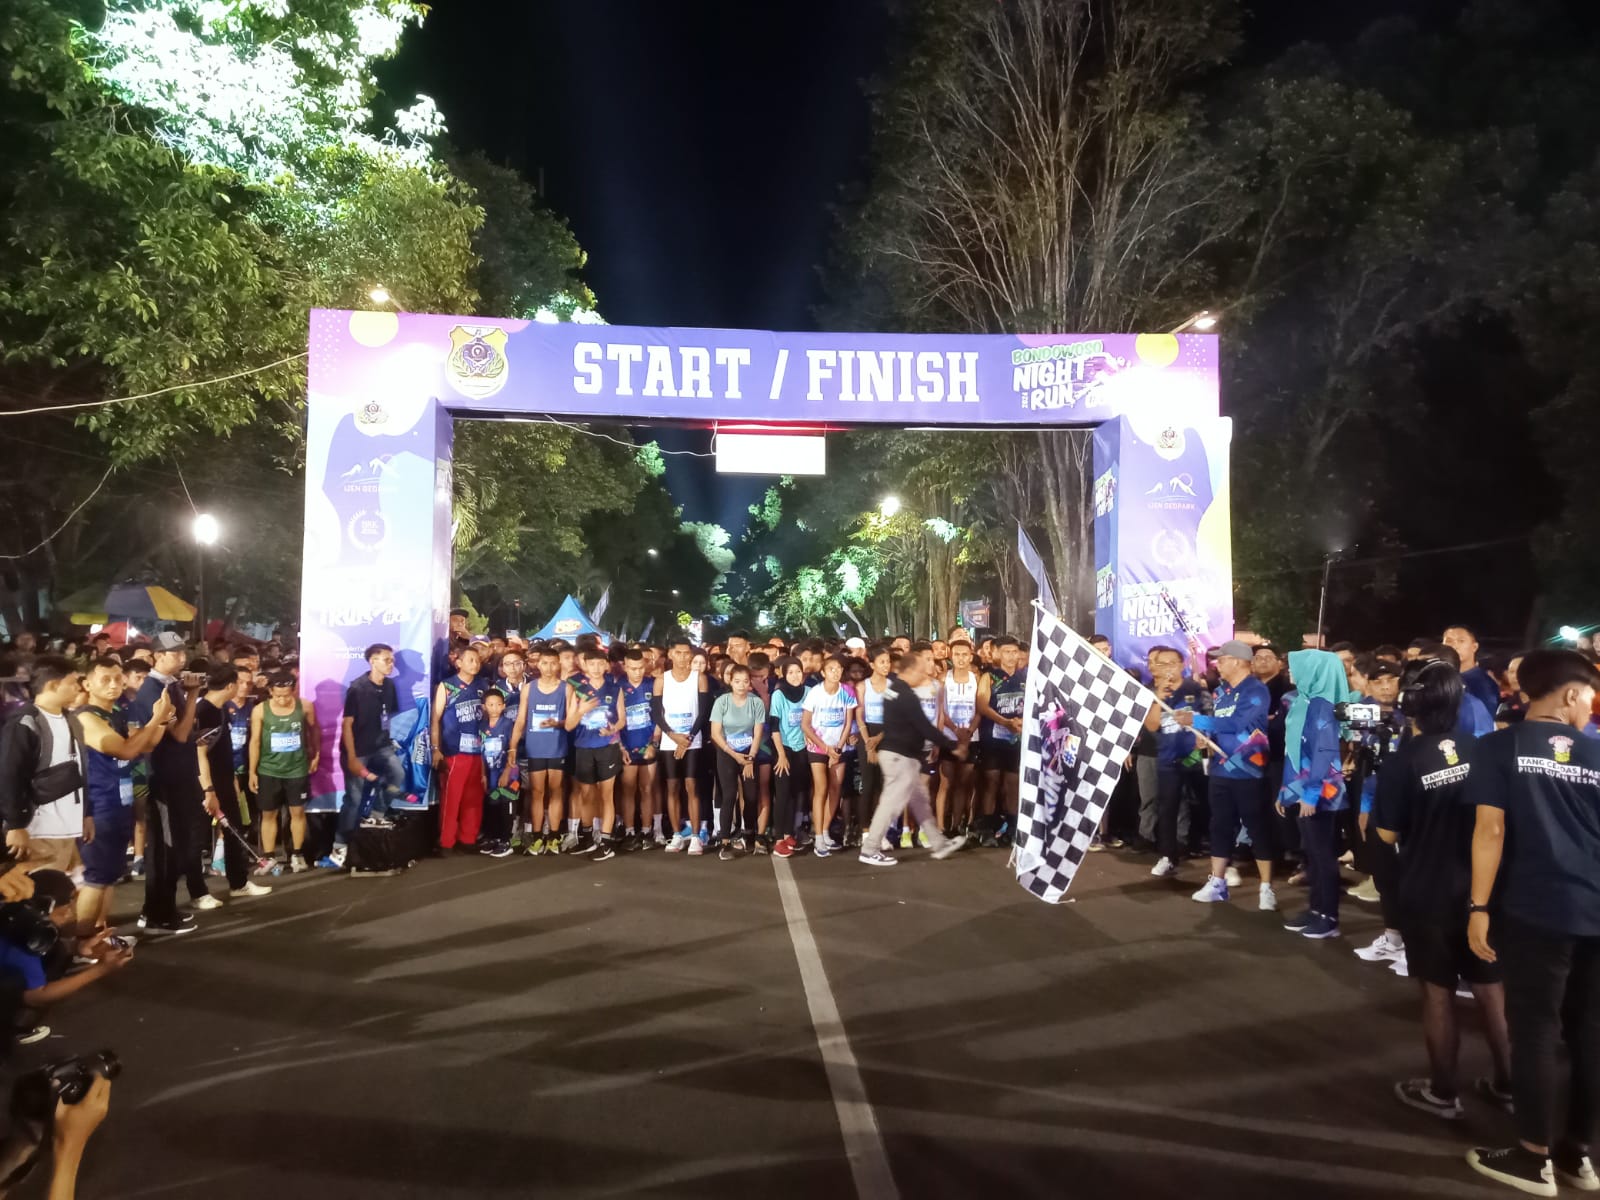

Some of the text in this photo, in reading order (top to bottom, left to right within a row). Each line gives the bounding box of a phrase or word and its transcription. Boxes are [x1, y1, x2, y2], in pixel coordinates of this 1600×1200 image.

[1012, 340, 1104, 366] BONDOWOSO
[573, 341, 980, 402] START / FINISH
[1013, 357, 1086, 392] NIGHT
[1030, 383, 1075, 410] RUN
[1137, 613, 1176, 637] RUN
[1424, 765, 1469, 783] YANG CERDAS
[1518, 766, 1543, 774] PILIH
[1520, 757, 1545, 766] YANG
[1547, 760, 1578, 775] CEDAS
